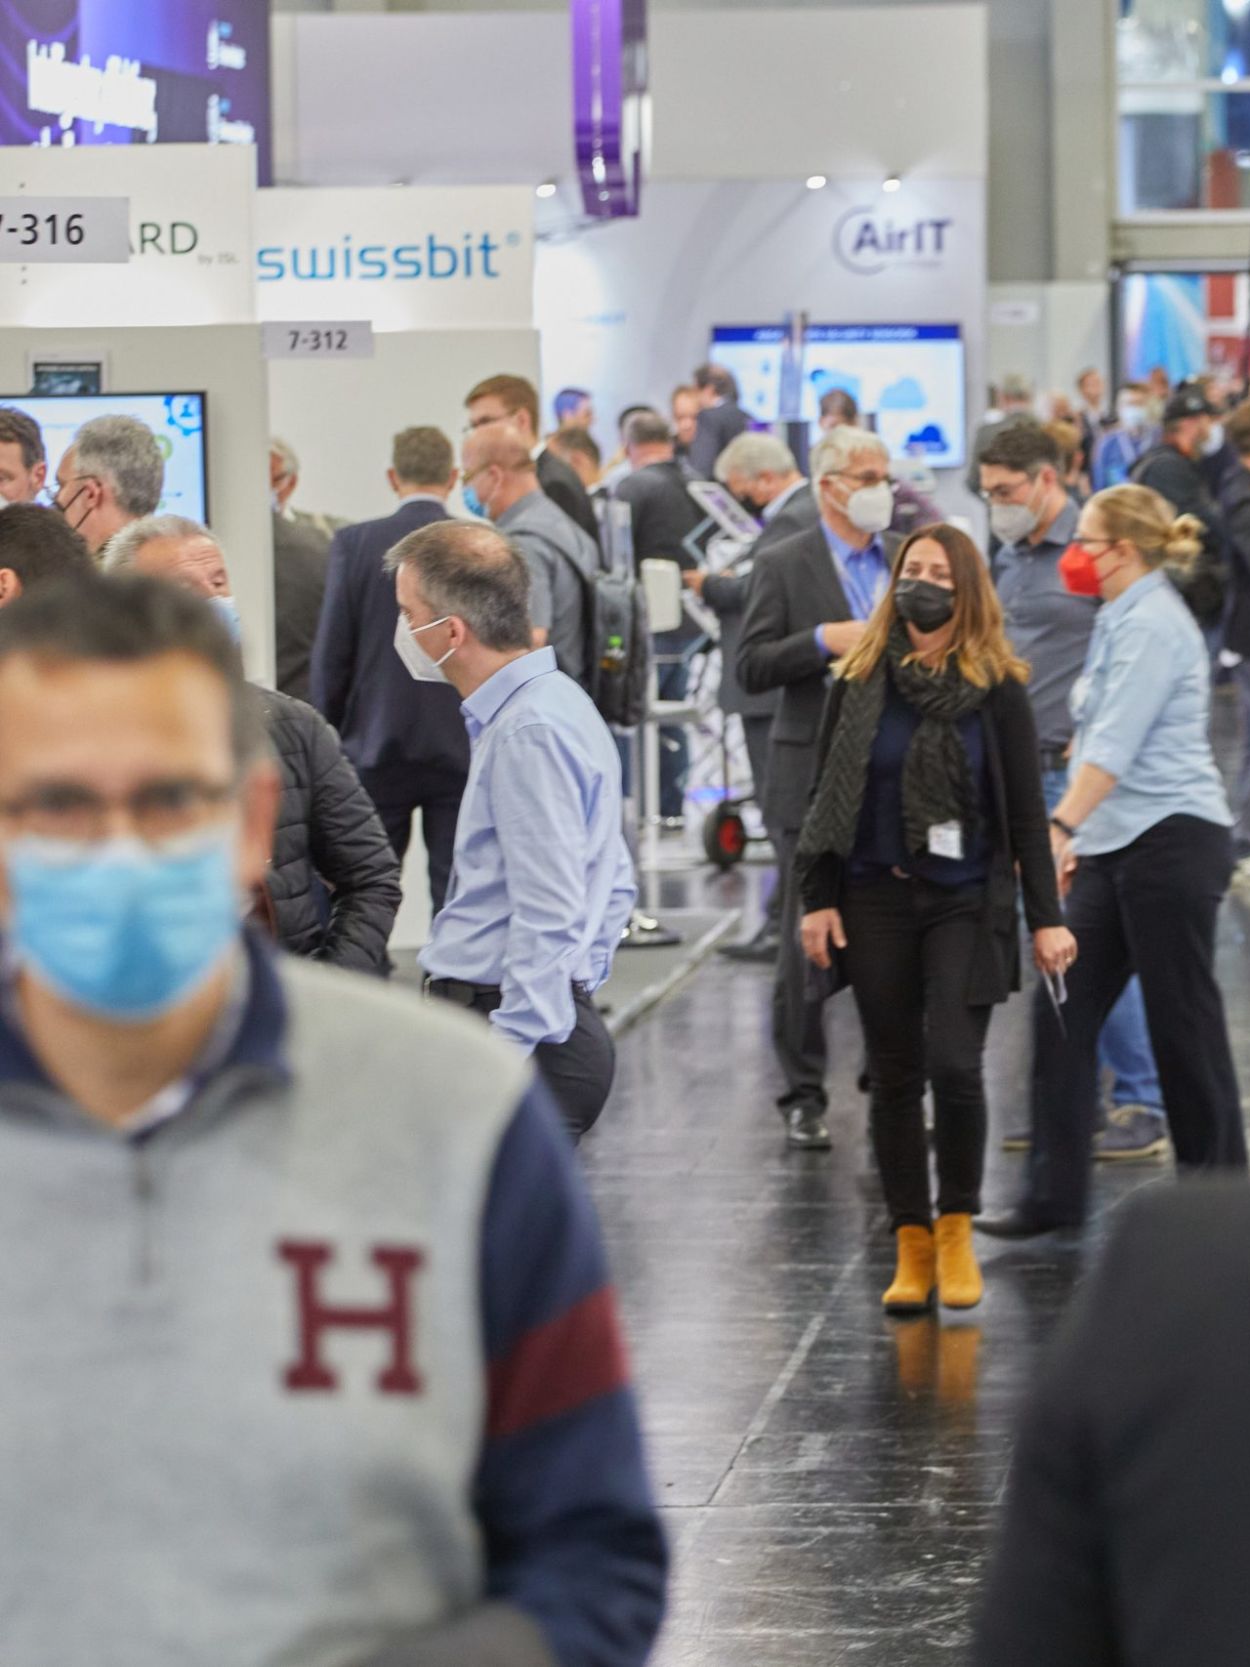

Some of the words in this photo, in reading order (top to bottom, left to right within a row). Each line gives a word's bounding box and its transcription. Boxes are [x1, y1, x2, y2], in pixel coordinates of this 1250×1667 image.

[0, 213, 85, 246] -316
[129, 221, 199, 255] RD
[287, 329, 349, 351] 7-312
[276, 1239, 424, 1395] H
